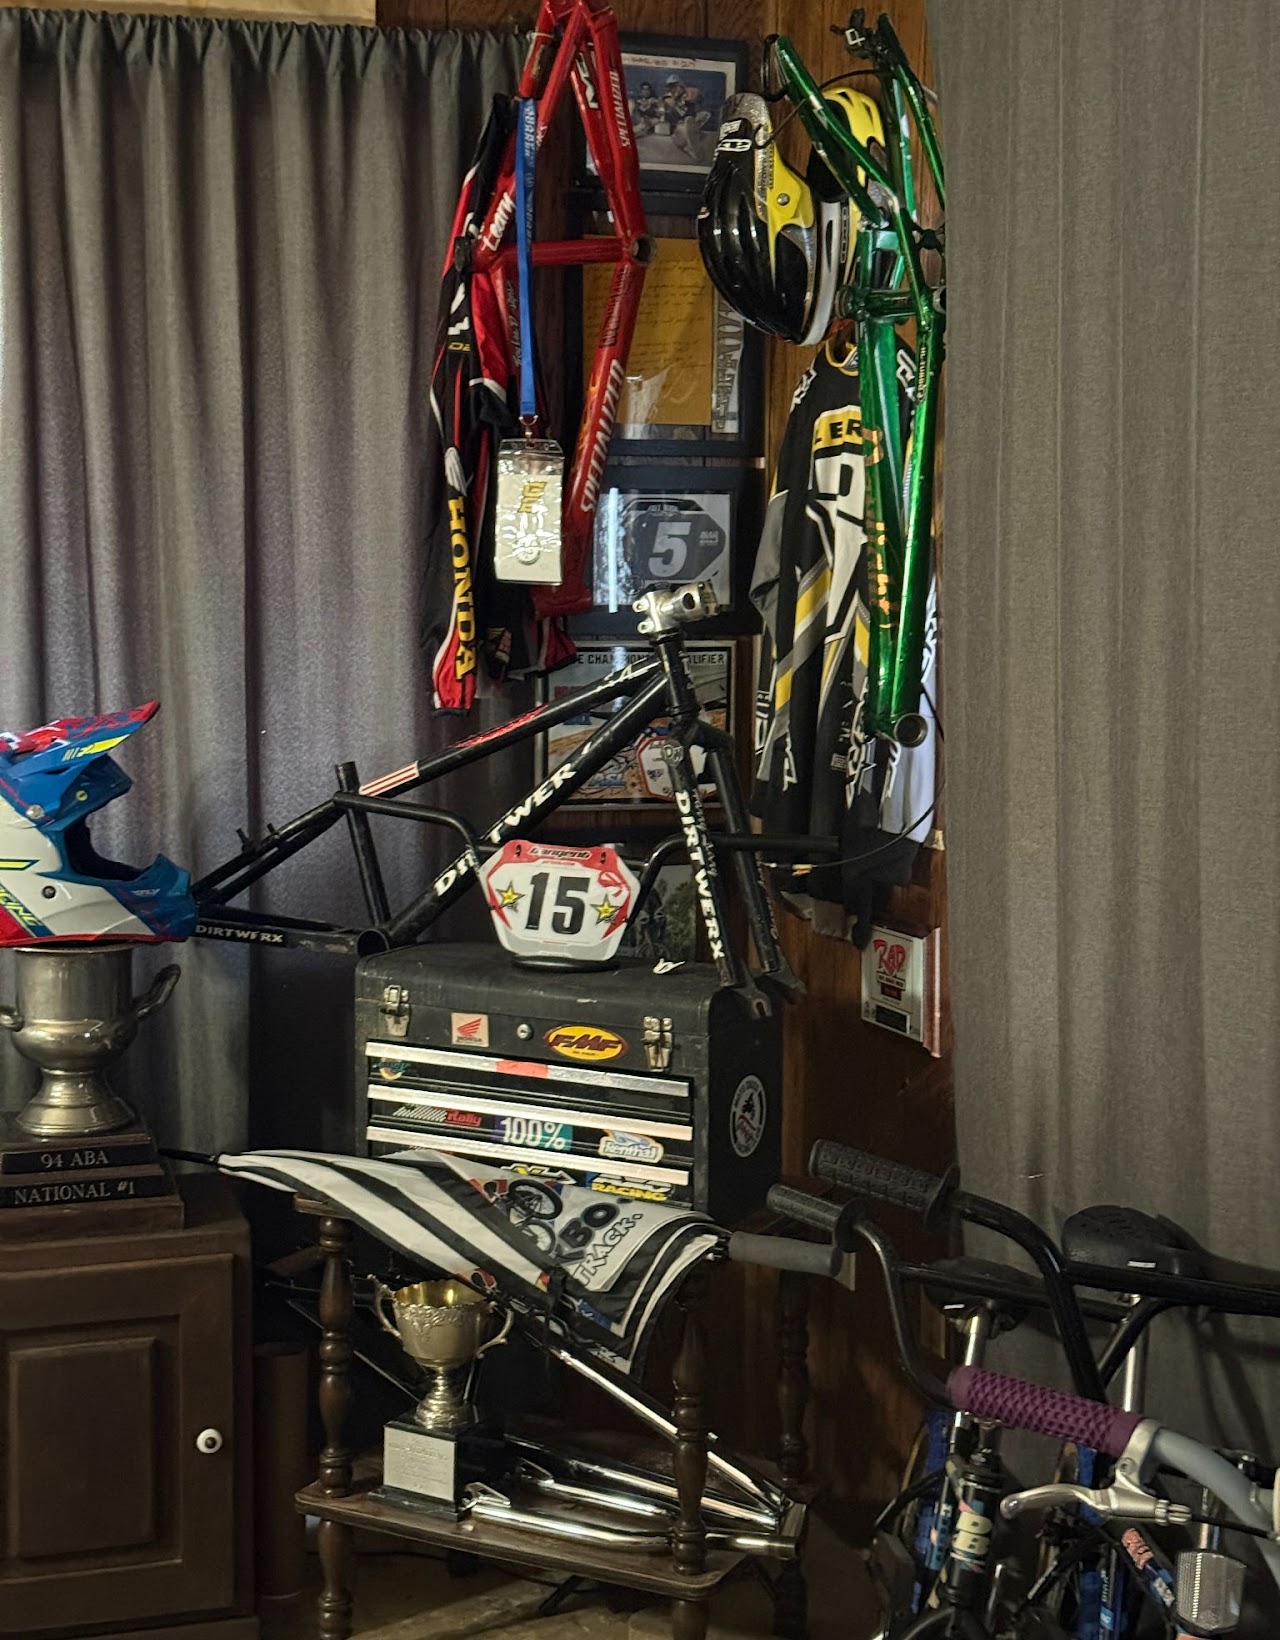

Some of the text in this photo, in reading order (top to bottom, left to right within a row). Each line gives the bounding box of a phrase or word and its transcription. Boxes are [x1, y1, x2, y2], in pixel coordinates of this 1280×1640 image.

[580, 358, 625, 513] SPECIALIZED
[648, 522, 692, 578] 5
[447, 496, 477, 681] HONDA
[674, 790, 725, 960] DIRTWERX
[524, 871, 592, 935] 15
[548, 1033, 623, 1052] FMF
[500, 1116, 567, 1151] 100%
[604, 1140, 659, 1160] Renthal
[40, 1150, 109, 1168] 94 ABA
[14, 1180, 136, 1205] NATIONAL #1
[590, 1181, 669, 1202] RACING
[572, 1212, 645, 1287] TRACK.
